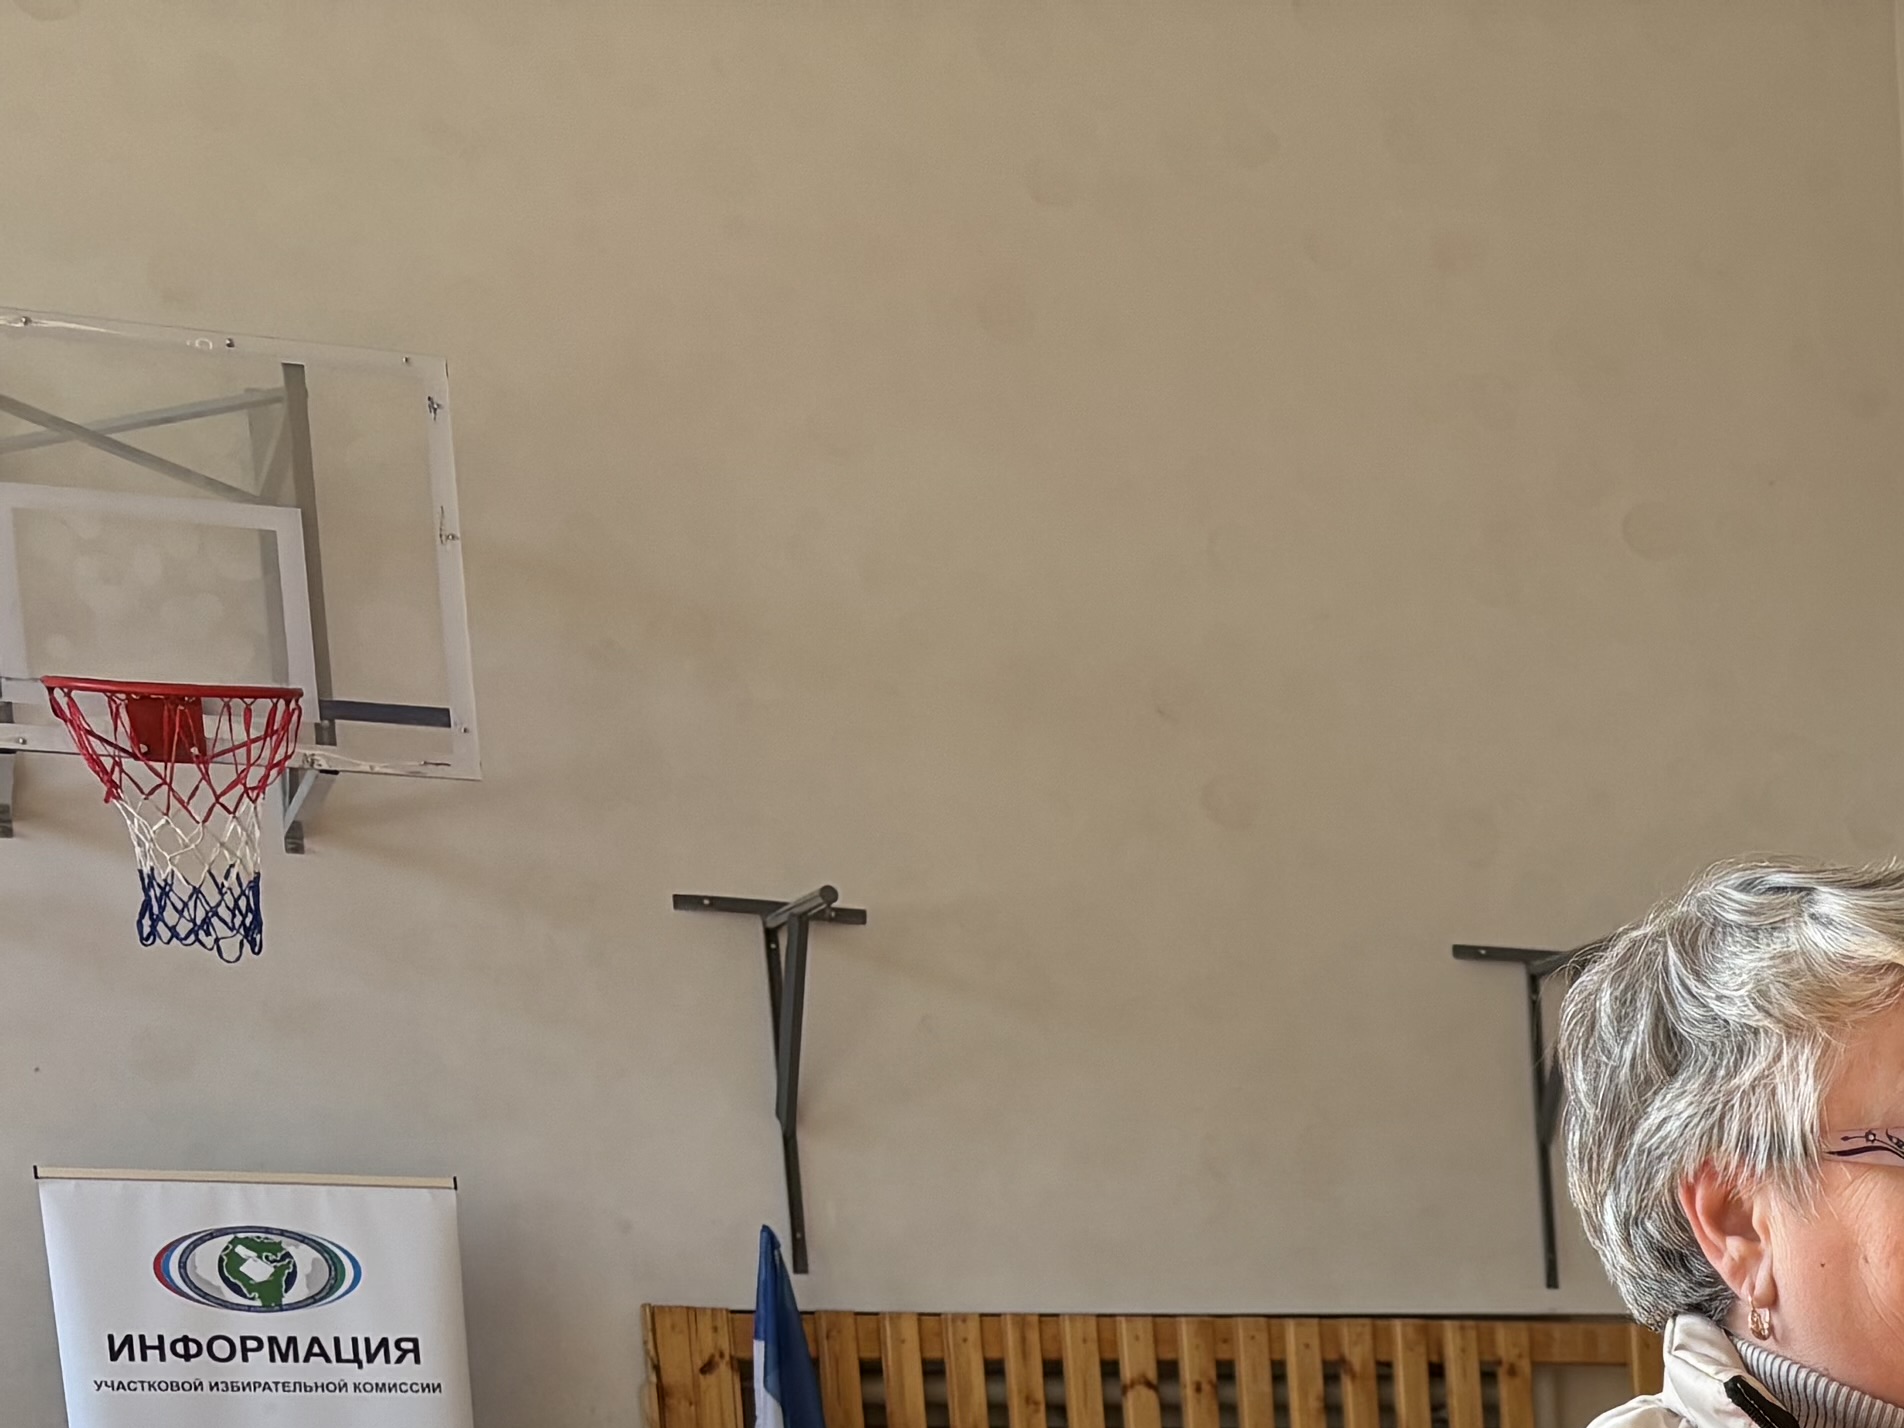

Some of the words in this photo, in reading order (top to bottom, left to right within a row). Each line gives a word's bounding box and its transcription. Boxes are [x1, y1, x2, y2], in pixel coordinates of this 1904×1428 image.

[106, 1333, 422, 1370] ИНФОРМАЦИЯ
[93, 1379, 204, 1393] УЧАСТКОВОЙ
[209, 1379, 348, 1394] ИЗБИРАТЕЛЬНОЙ
[353, 1381, 442, 1395] КОМИССИИ
